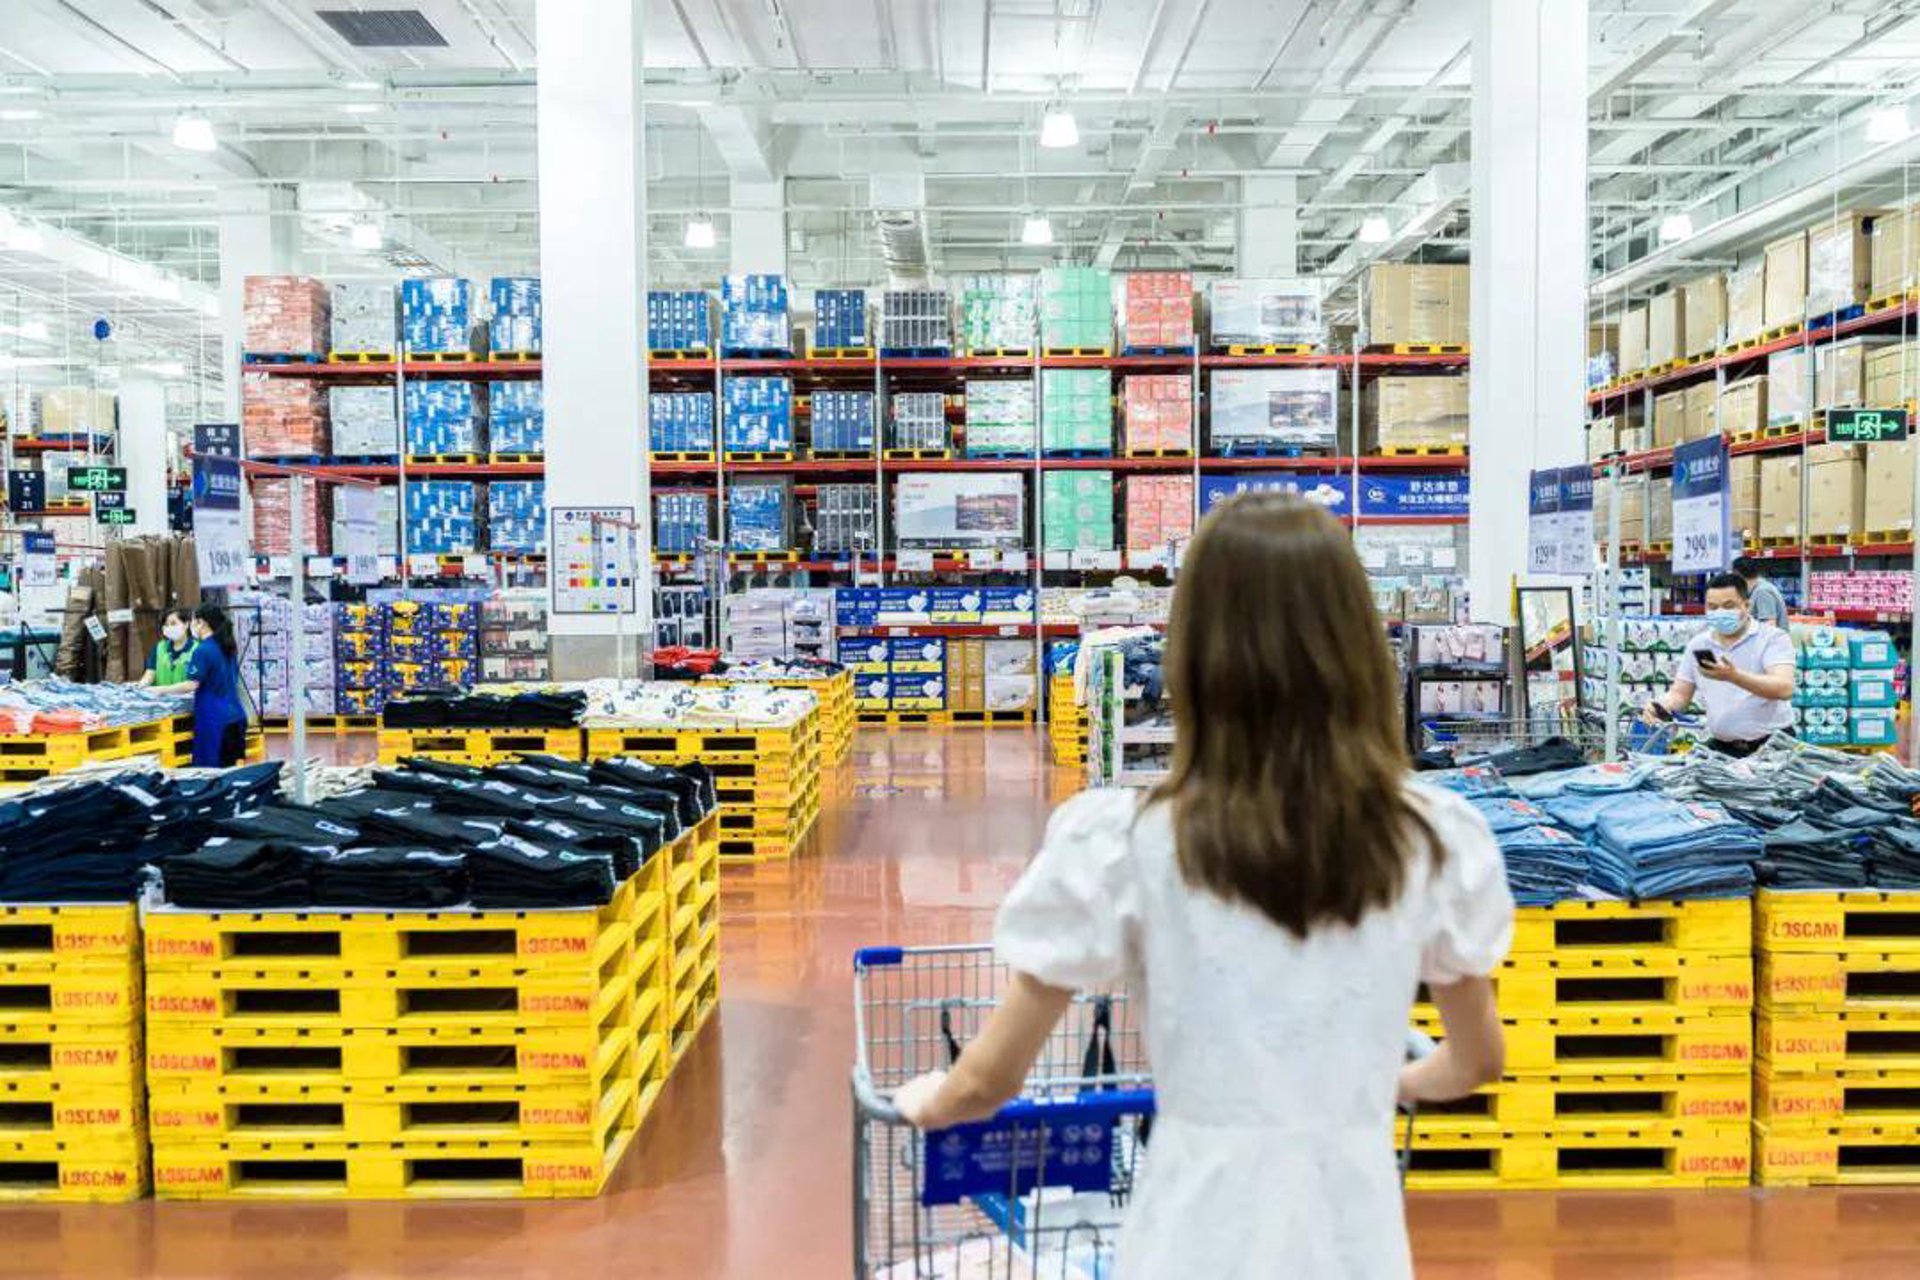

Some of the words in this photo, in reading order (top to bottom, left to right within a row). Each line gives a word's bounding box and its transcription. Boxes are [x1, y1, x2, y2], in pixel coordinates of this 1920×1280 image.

[1772, 922, 1838, 938] LOSCAM
[147, 938, 216, 956] LOSCAM
[520, 937, 586, 953] LOSCAM
[55, 992, 119, 1008] LOSCAM
[149, 996, 217, 1013] LOSCAM
[522, 996, 589, 1011] LOSCAM
[55, 1050, 119, 1067] LOSCAM
[521, 1052, 587, 1069] LOSCAM
[1680, 1044, 1748, 1060] LOSCAM
[150, 1055, 217, 1072] LOSCAM
[1680, 1099, 1747, 1116] LOSCAM
[57, 1109, 121, 1125] LOSCAM
[523, 1109, 589, 1125] LOSCAM
[527, 1164, 593, 1181] LOSCAM
[1680, 1156, 1747, 1173] LOSCAM
[62, 1171, 127, 1187] LOSCAM
[156, 1166, 224, 1185] LOSCAM
